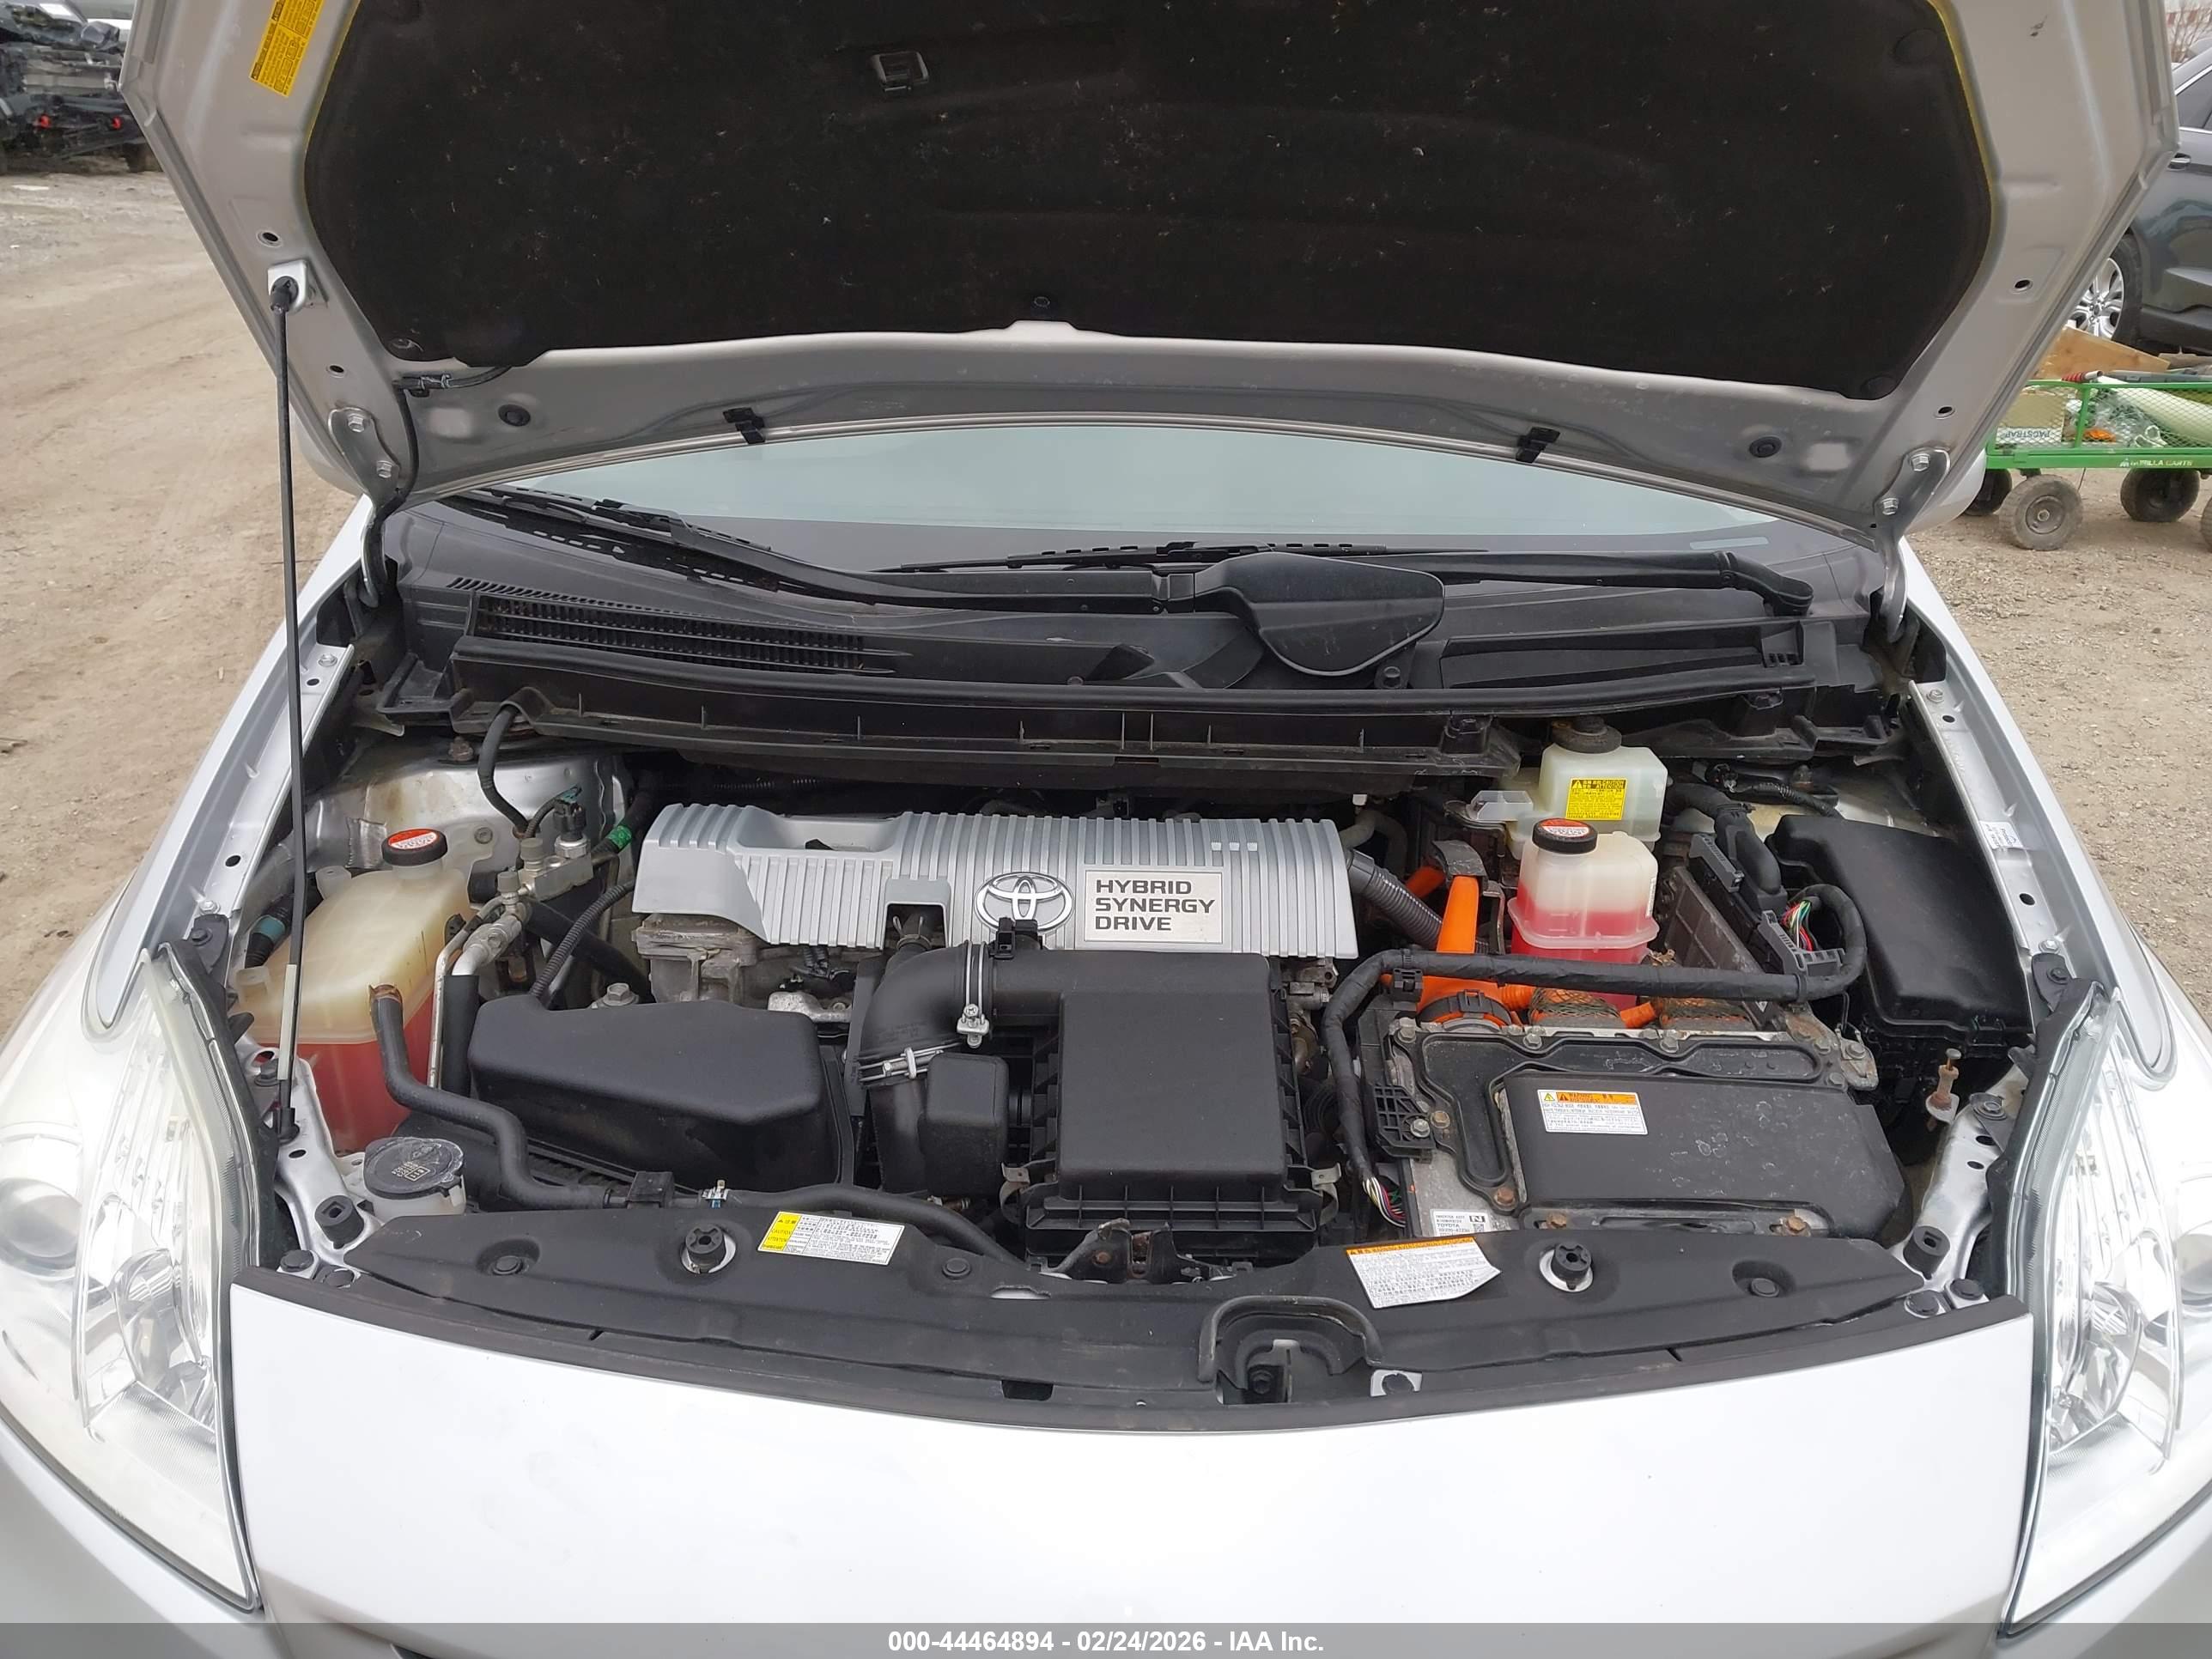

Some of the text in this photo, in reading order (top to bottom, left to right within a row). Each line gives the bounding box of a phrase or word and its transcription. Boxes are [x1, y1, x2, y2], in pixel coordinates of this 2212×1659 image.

[1096, 879, 1192, 895] HYBRID
[1095, 897, 1215, 914] SYNERGY
[1095, 916, 1172, 931] DRIVE
